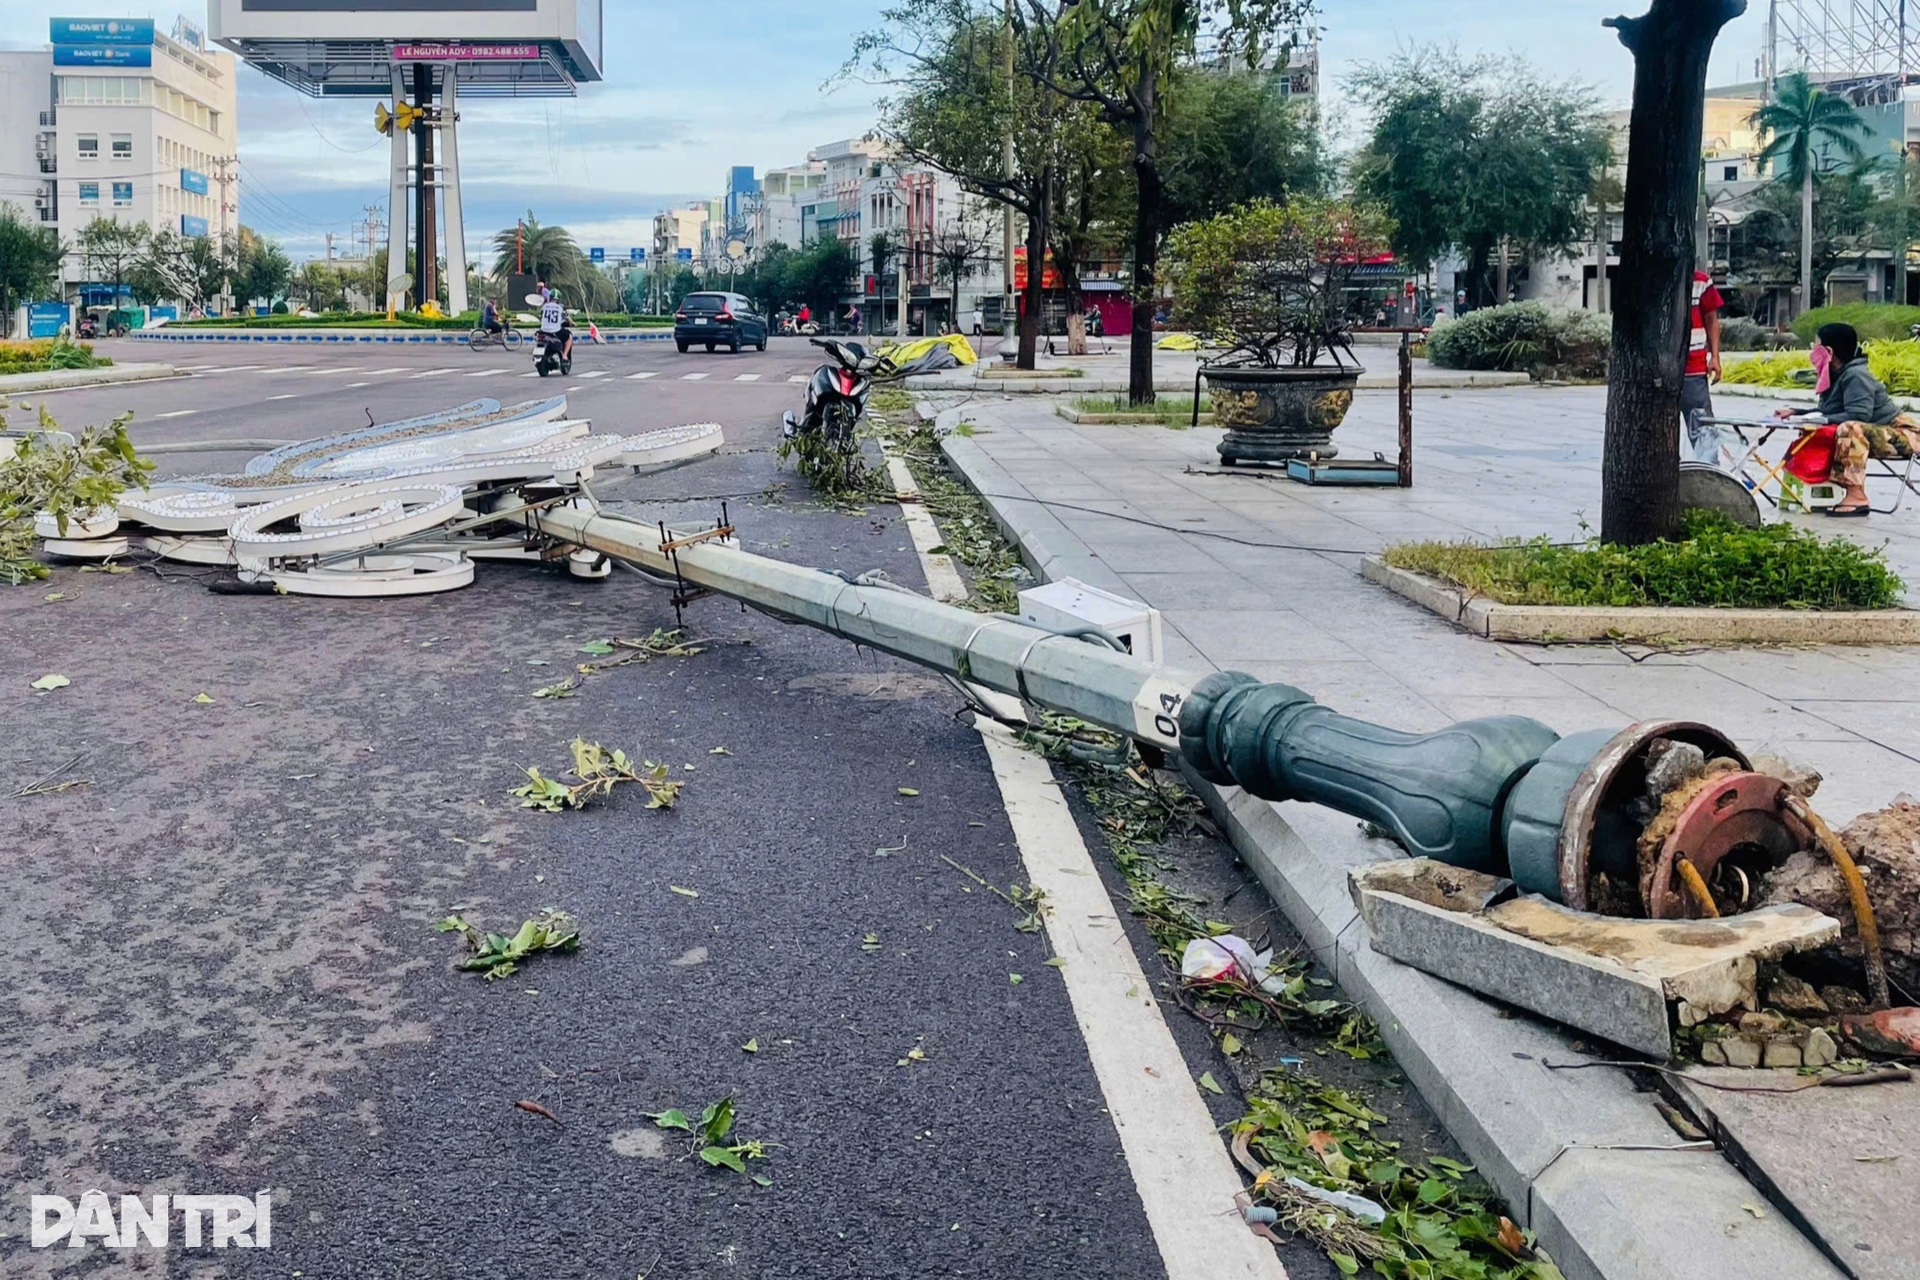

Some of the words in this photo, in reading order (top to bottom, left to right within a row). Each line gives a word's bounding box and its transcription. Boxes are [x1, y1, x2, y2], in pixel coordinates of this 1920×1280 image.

[69, 23, 106, 32] BAOVIET
[448, 47, 467, 56] ADV
[544, 309, 559, 323] 43
[1155, 693, 1182, 738] 04
